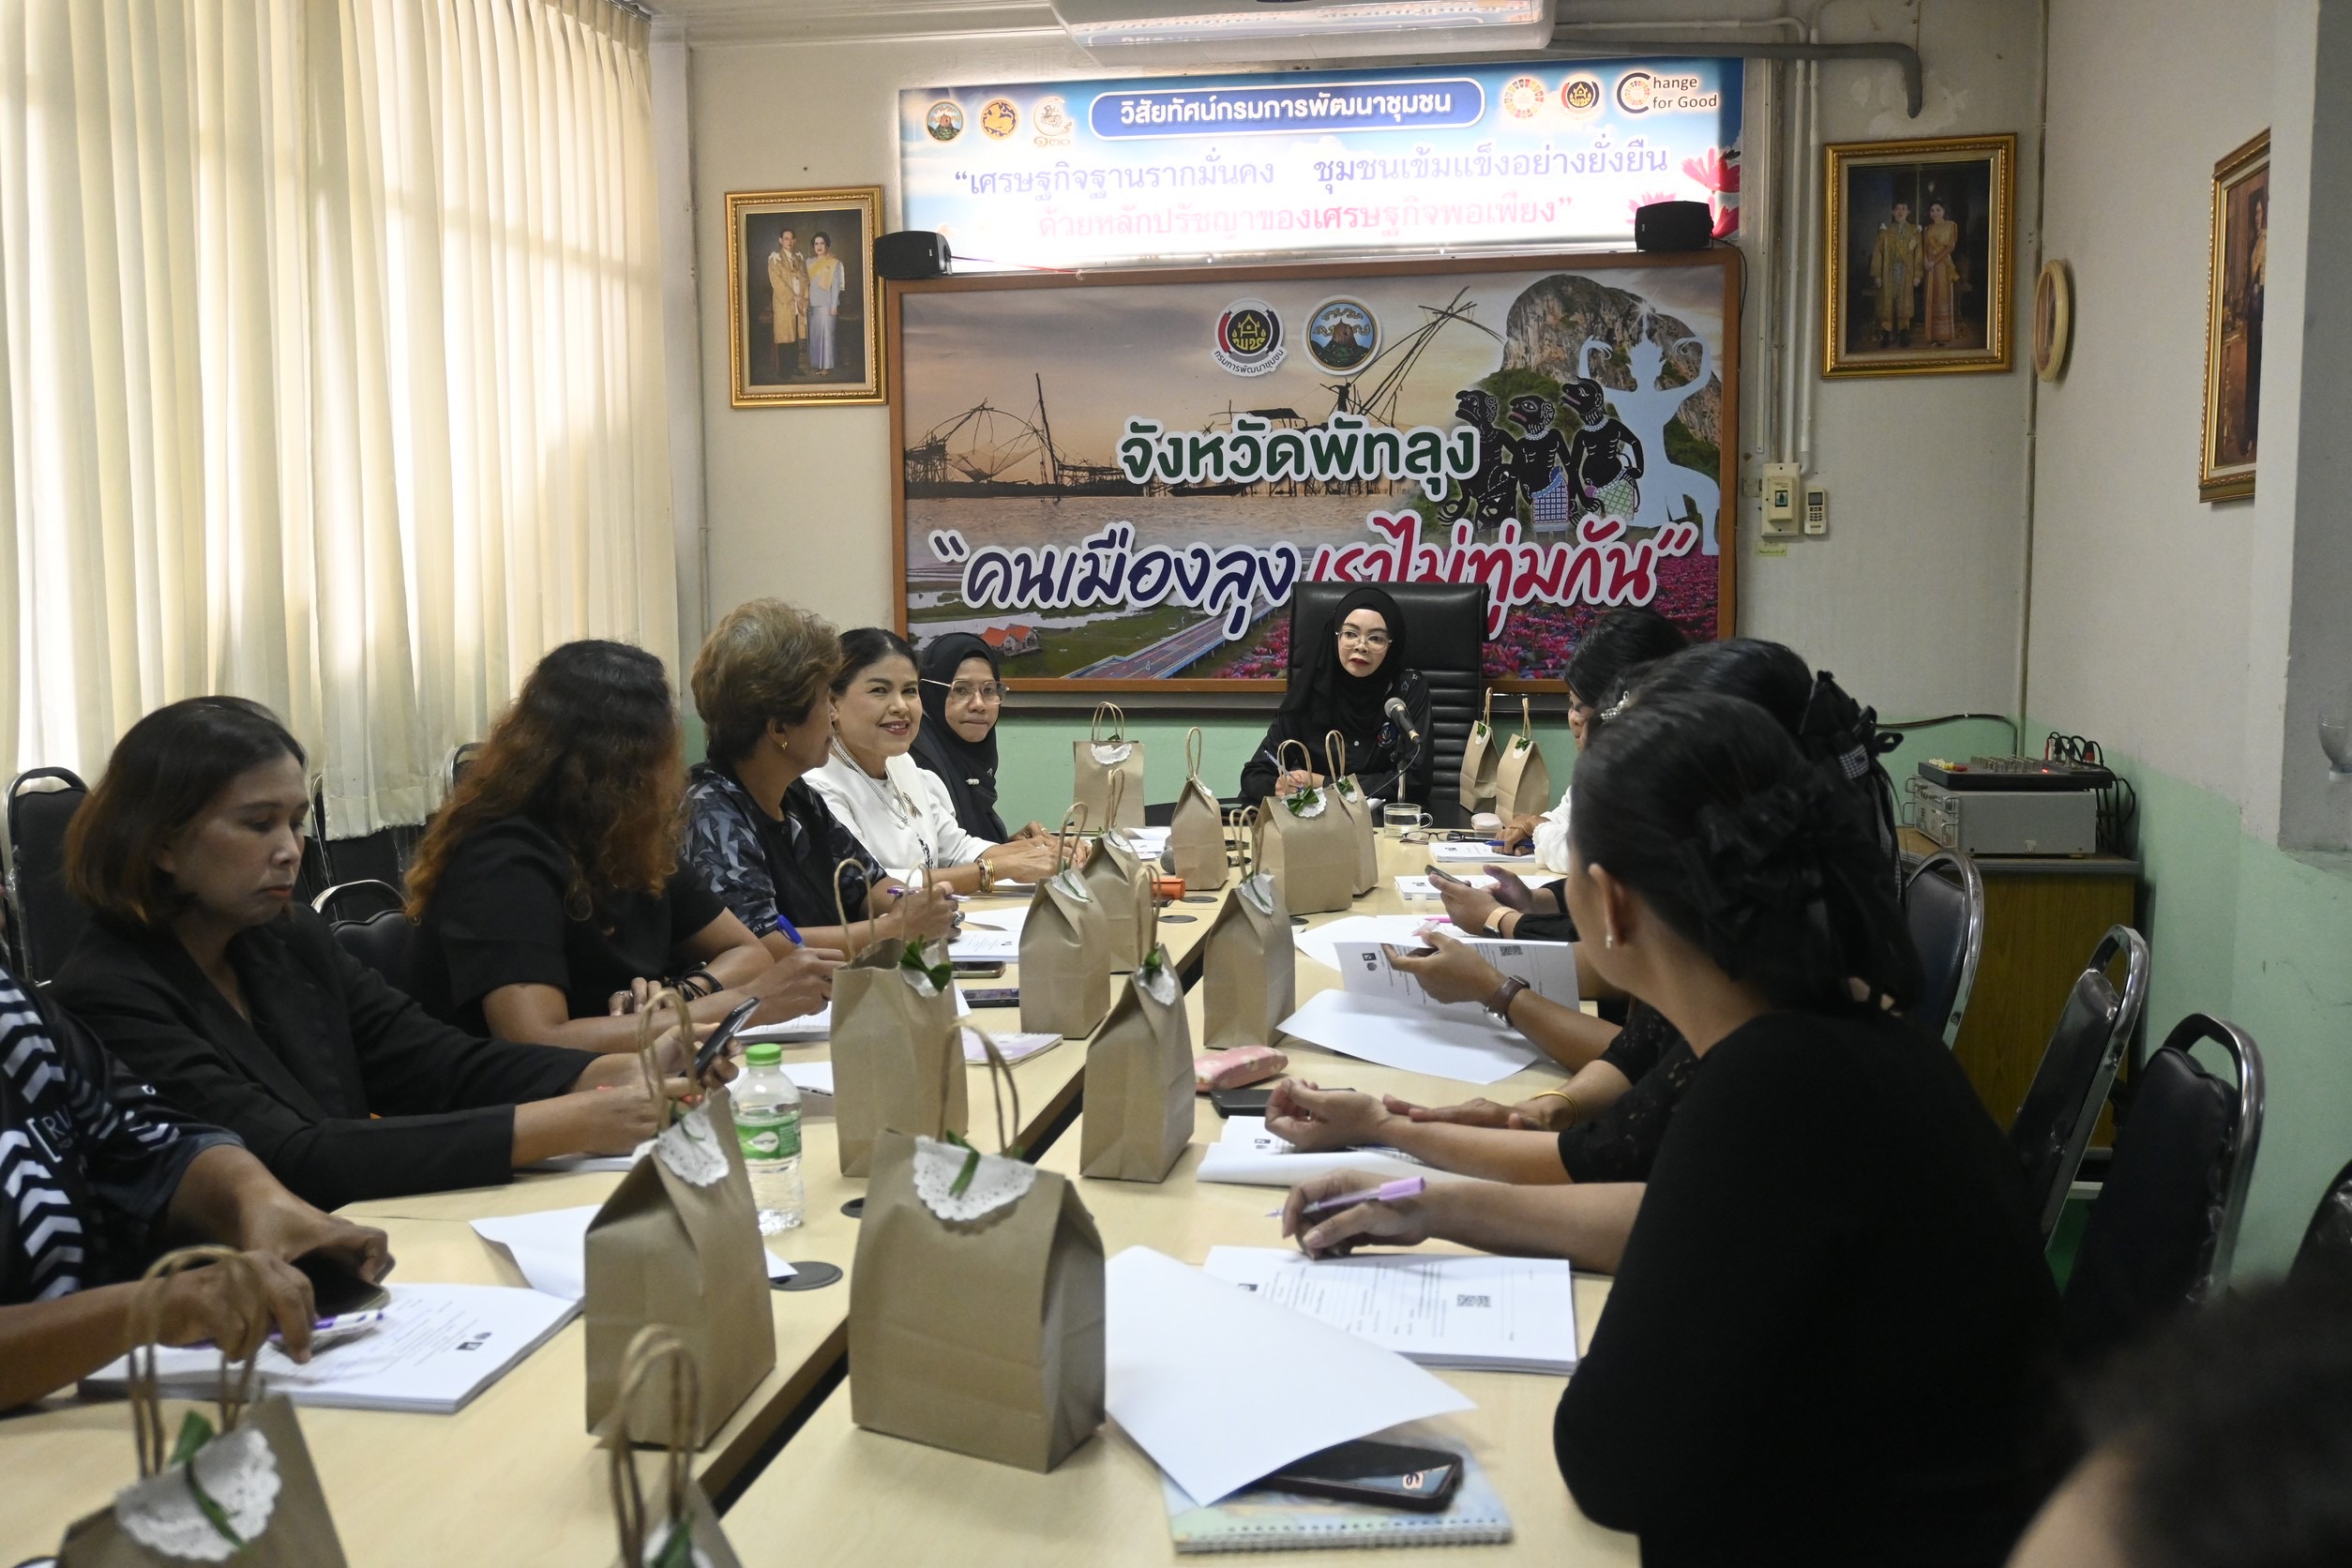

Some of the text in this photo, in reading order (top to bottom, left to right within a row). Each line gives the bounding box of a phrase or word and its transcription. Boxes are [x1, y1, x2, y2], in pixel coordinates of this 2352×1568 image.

[1120, 91, 1452, 126] วิสัยทัศน์กรมการพัฒนาชุมชน
[1652, 94, 1717, 109] for Good
[1313, 132, 1668, 195] ชุมชนเข้มแข็งอย่างยั่งยืน
[1214, 350, 1284, 374] กรมการพัฒนาชุมชน
[1120, 417, 1475, 497] จังหวัดพัทลุง
[933, 526, 1297, 635] “คนเมืองลุง
